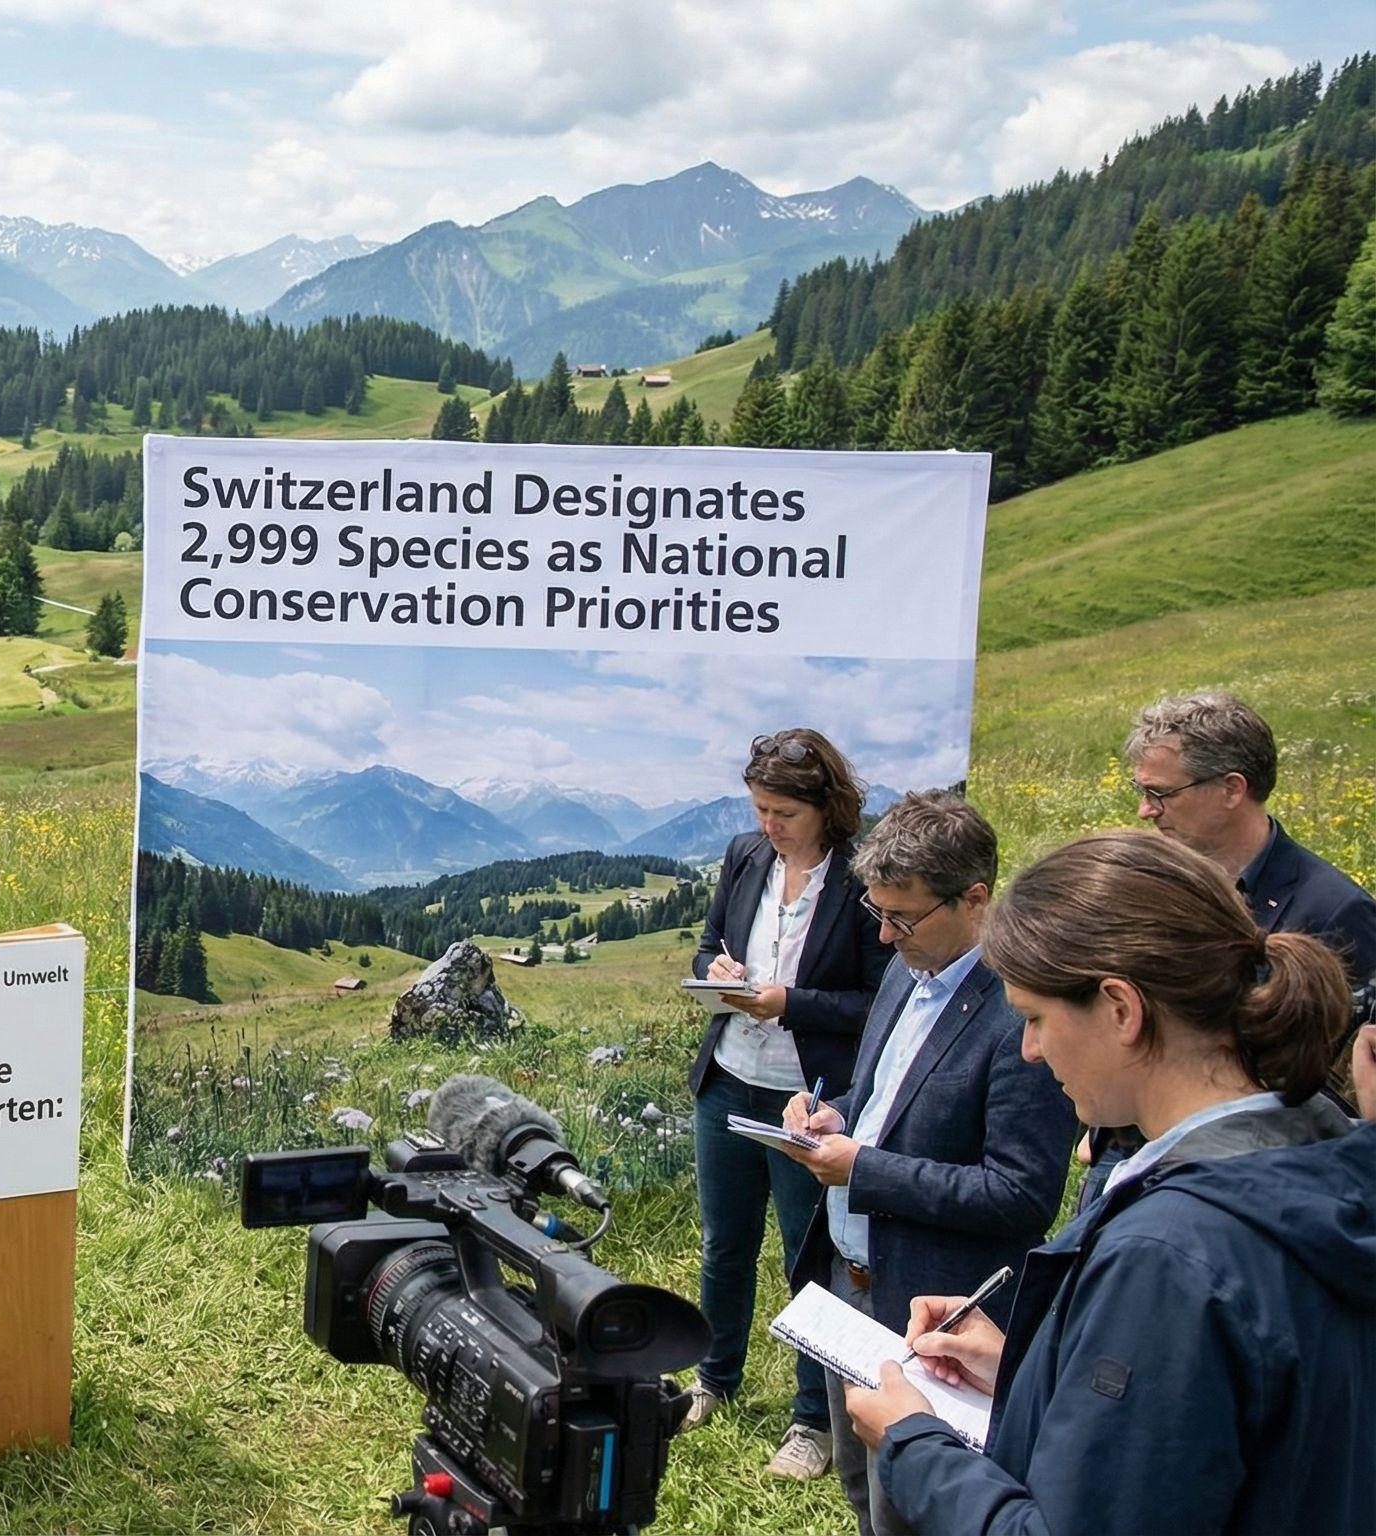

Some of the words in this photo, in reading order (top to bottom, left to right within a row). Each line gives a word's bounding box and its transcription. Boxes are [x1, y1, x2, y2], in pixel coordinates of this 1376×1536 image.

[183, 466, 493, 515] Switzerland
[514, 473, 806, 530] Designates
[181, 521, 319, 569] 2,999
[338, 525, 530, 579] Species
[547, 540, 603, 573] as
[622, 532, 847, 579] National
[180, 577, 524, 627] Conservation
[546, 585, 780, 634] Priorities
[3, 965, 69, 987] Umwelt
